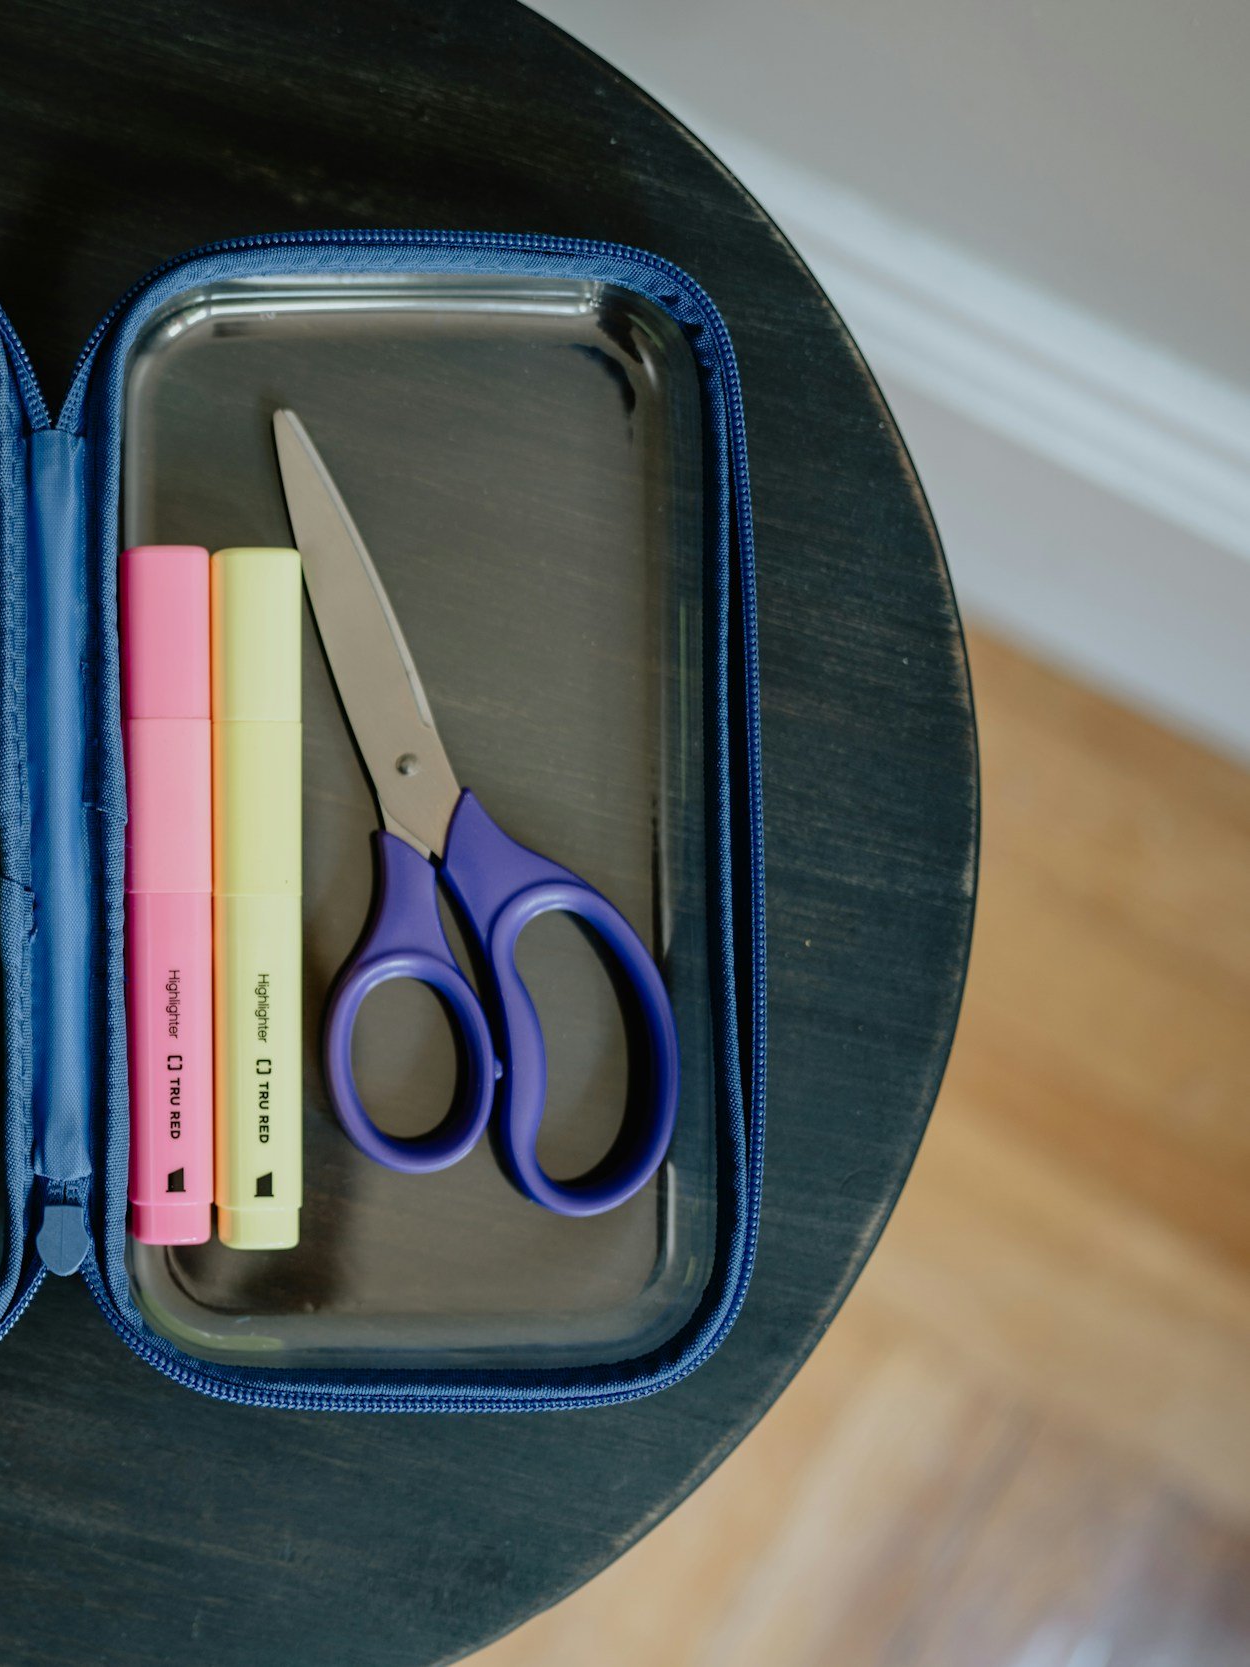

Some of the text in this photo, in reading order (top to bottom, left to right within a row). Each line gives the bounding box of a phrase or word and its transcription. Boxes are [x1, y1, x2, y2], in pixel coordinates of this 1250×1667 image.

[165, 969, 181, 1039] Highlighter
[254, 973, 270, 1043] Highlighter
[169, 1077, 181, 1140] TRU RED
[258, 1081, 270, 1144] TRU RED
